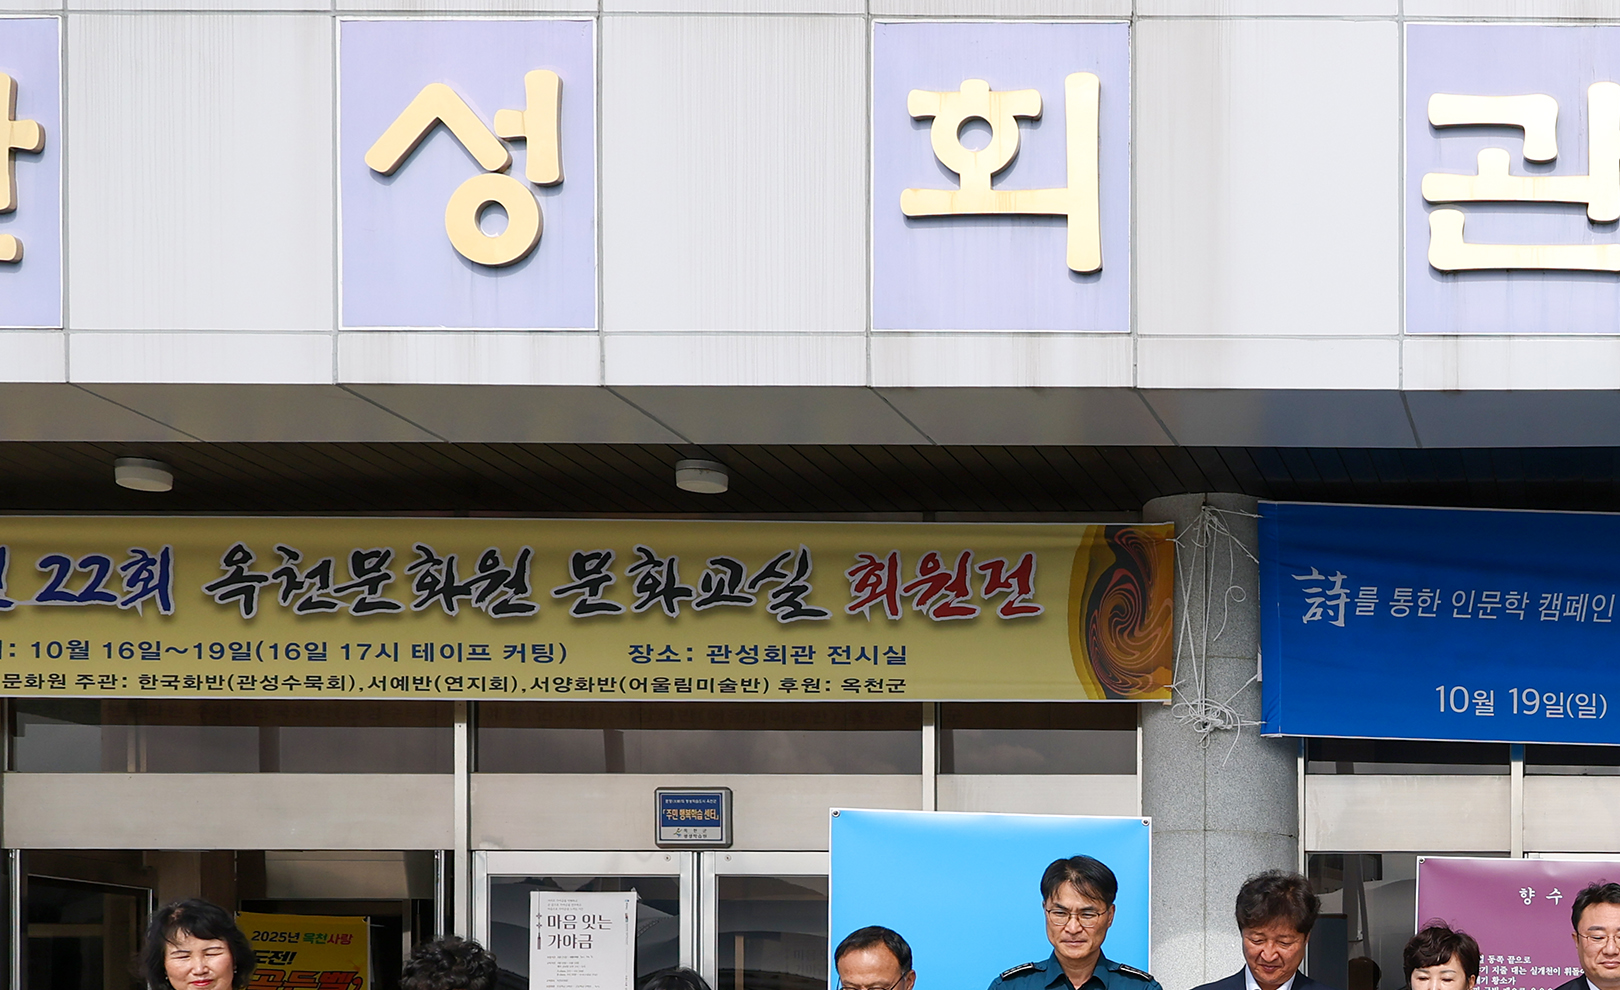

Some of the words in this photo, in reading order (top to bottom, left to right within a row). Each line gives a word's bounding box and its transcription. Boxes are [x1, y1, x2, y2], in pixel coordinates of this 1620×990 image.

[35, 545, 173, 615] 22회
[203, 543, 538, 620] 옥천문화원
[553, 545, 829, 622] 문화교실
[848, 550, 1042, 619] 회원전
[1389, 587, 1442, 618] 통한
[1451, 590, 1530, 621] 인문학
[1537, 592, 1616, 623] 캠페인
[31, 640, 90, 660] 10월
[340, 643, 399, 663] 17시
[411, 643, 492, 663] 테이프
[503, 643, 567, 665] 커팅)
[628, 644, 693, 664] 장소:
[706, 645, 817, 665] 관성회관
[827, 645, 907, 665] 전시실
[75, 674, 127, 690] 주관:
[778, 678, 831, 694] 후원:
[841, 678, 906, 694] 옥천군
[1435, 685, 1495, 717] 10월
[1508, 687, 1608, 719] 19일(일)
[547, 914, 577, 930] 마음
[582, 914, 612, 930] 잇는
[251, 930, 300, 943] 2025년
[303, 932, 354, 946] 옥천사랑
[547, 933, 593, 949] 가야금
[1507, 955, 1532, 965] 끝으로
[1511, 967, 1528, 976] 대는
[1530, 966, 1561, 976] 실개천이
[1491, 976, 1517, 986] 황소가
